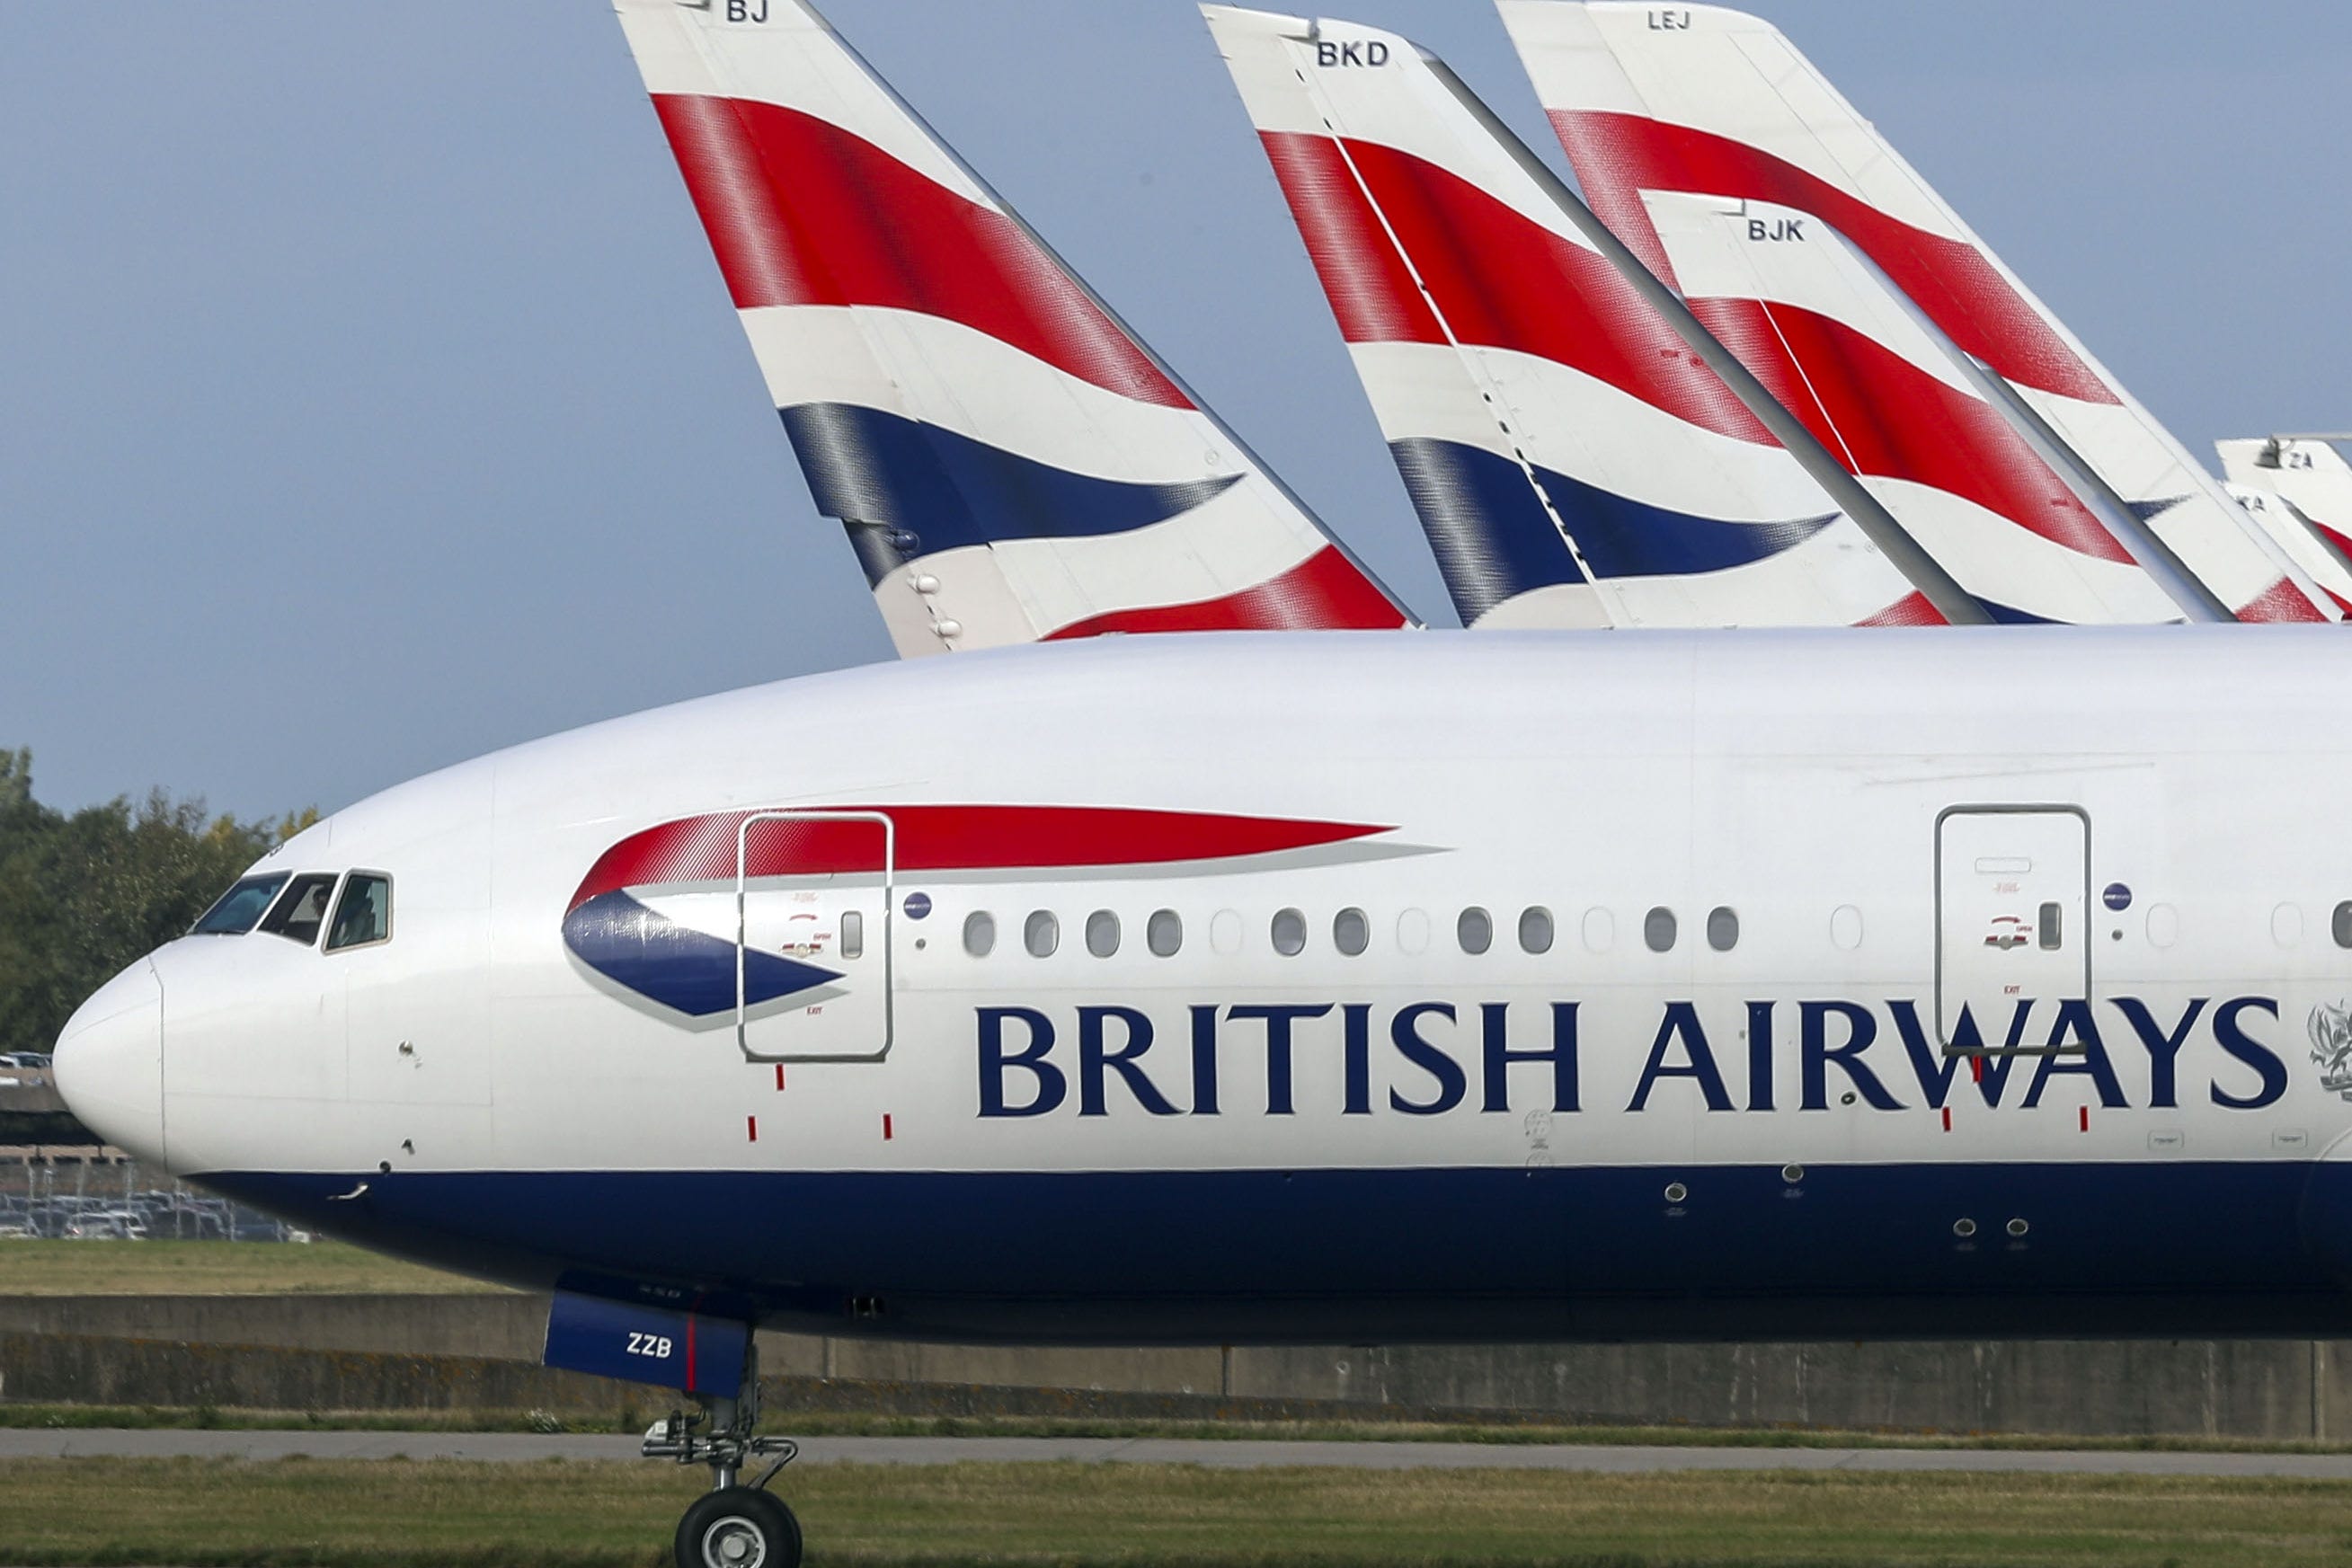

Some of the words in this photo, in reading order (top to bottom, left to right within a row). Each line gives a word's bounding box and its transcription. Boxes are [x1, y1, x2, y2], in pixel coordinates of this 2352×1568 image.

[1647, 11, 1690, 30] LEJ
[1318, 41, 1389, 66] BKD
[1748, 219, 1805, 242] BJK
[974, 1001, 1583, 1118] BRITISH
[1623, 997, 2288, 1112] AIRWAYS
[626, 1332, 672, 1359] ZZB
